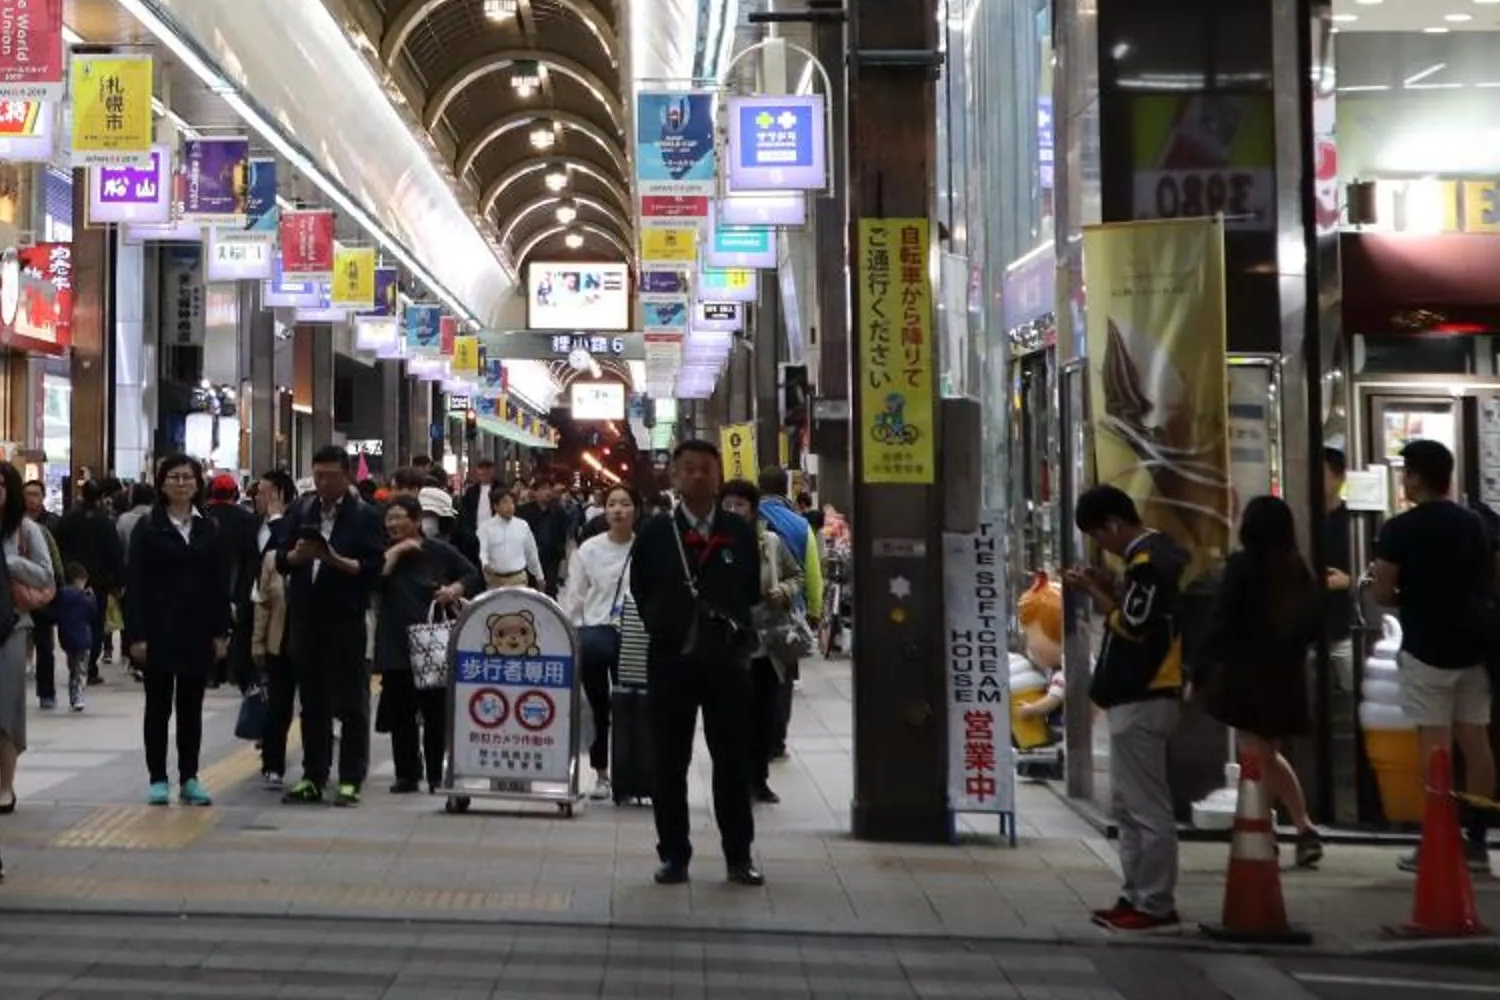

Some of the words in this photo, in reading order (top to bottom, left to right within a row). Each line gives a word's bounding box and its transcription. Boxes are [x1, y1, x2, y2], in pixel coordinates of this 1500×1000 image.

[2, 7, 15, 55] Union
[16, 14, 29, 61] World
[107, 77, 124, 130] 札幌市
[868, 227, 890, 388] ご通行ください
[901, 226, 923, 387] 自転車から降りて
[612, 337, 624, 353] 6
[974, 523, 995, 565] THE
[462, 659, 564, 684] 歩行者専用
[951, 630, 974, 703] HOUSE
[470, 732, 554, 747] 防犯カメラ作動中
[963, 709, 997, 803] 営業中
